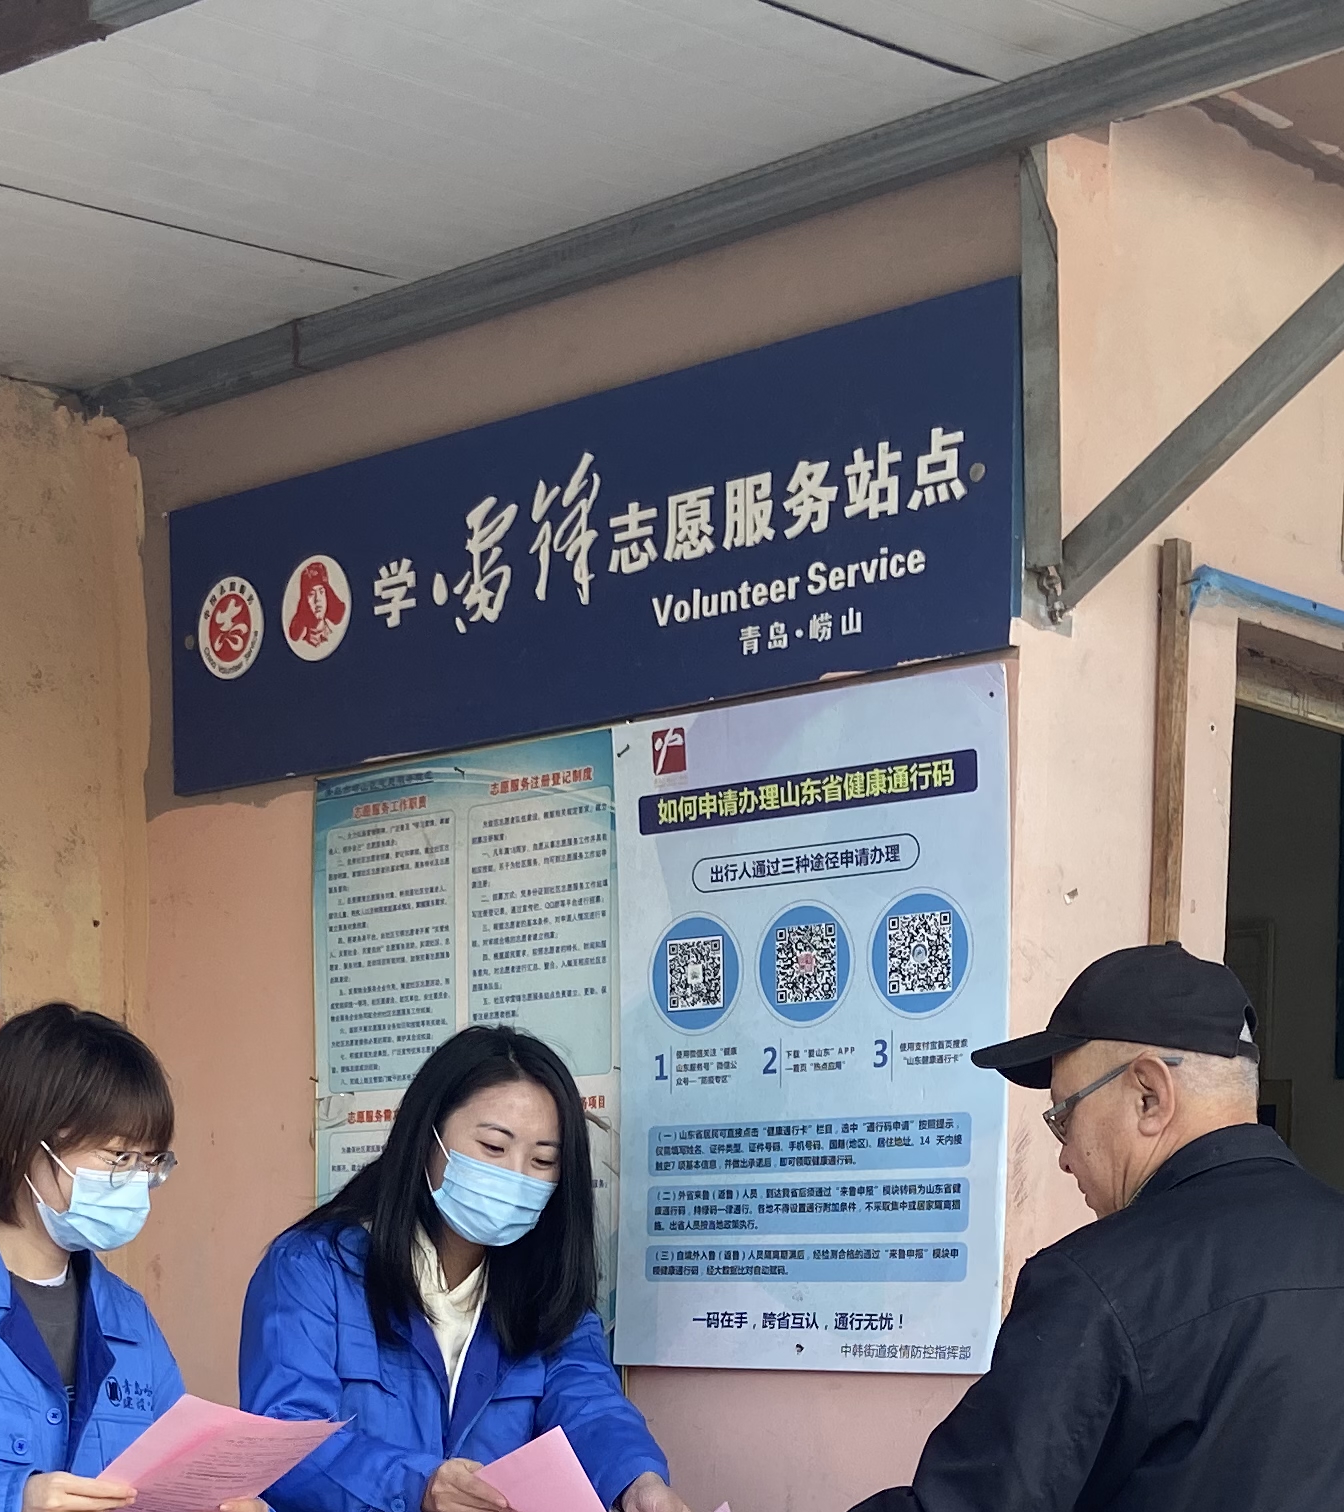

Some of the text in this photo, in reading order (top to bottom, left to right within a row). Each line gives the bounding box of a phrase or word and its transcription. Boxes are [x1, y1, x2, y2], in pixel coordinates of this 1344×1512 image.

[652, 546, 925, 627] Volunteer Service
[490, 767, 593, 795] 志愿服务注册登记制度
[657, 758, 955, 825] 如何申请办理山东省健康通行码
[709, 843, 901, 884] 出行人通过三种途径申请办理
[655, 1053, 668, 1081] 1
[762, 1046, 777, 1074] 2
[873, 1039, 888, 1068] 3
[840, 1343, 972, 1360] 中韩街道疫情防控指挥部
